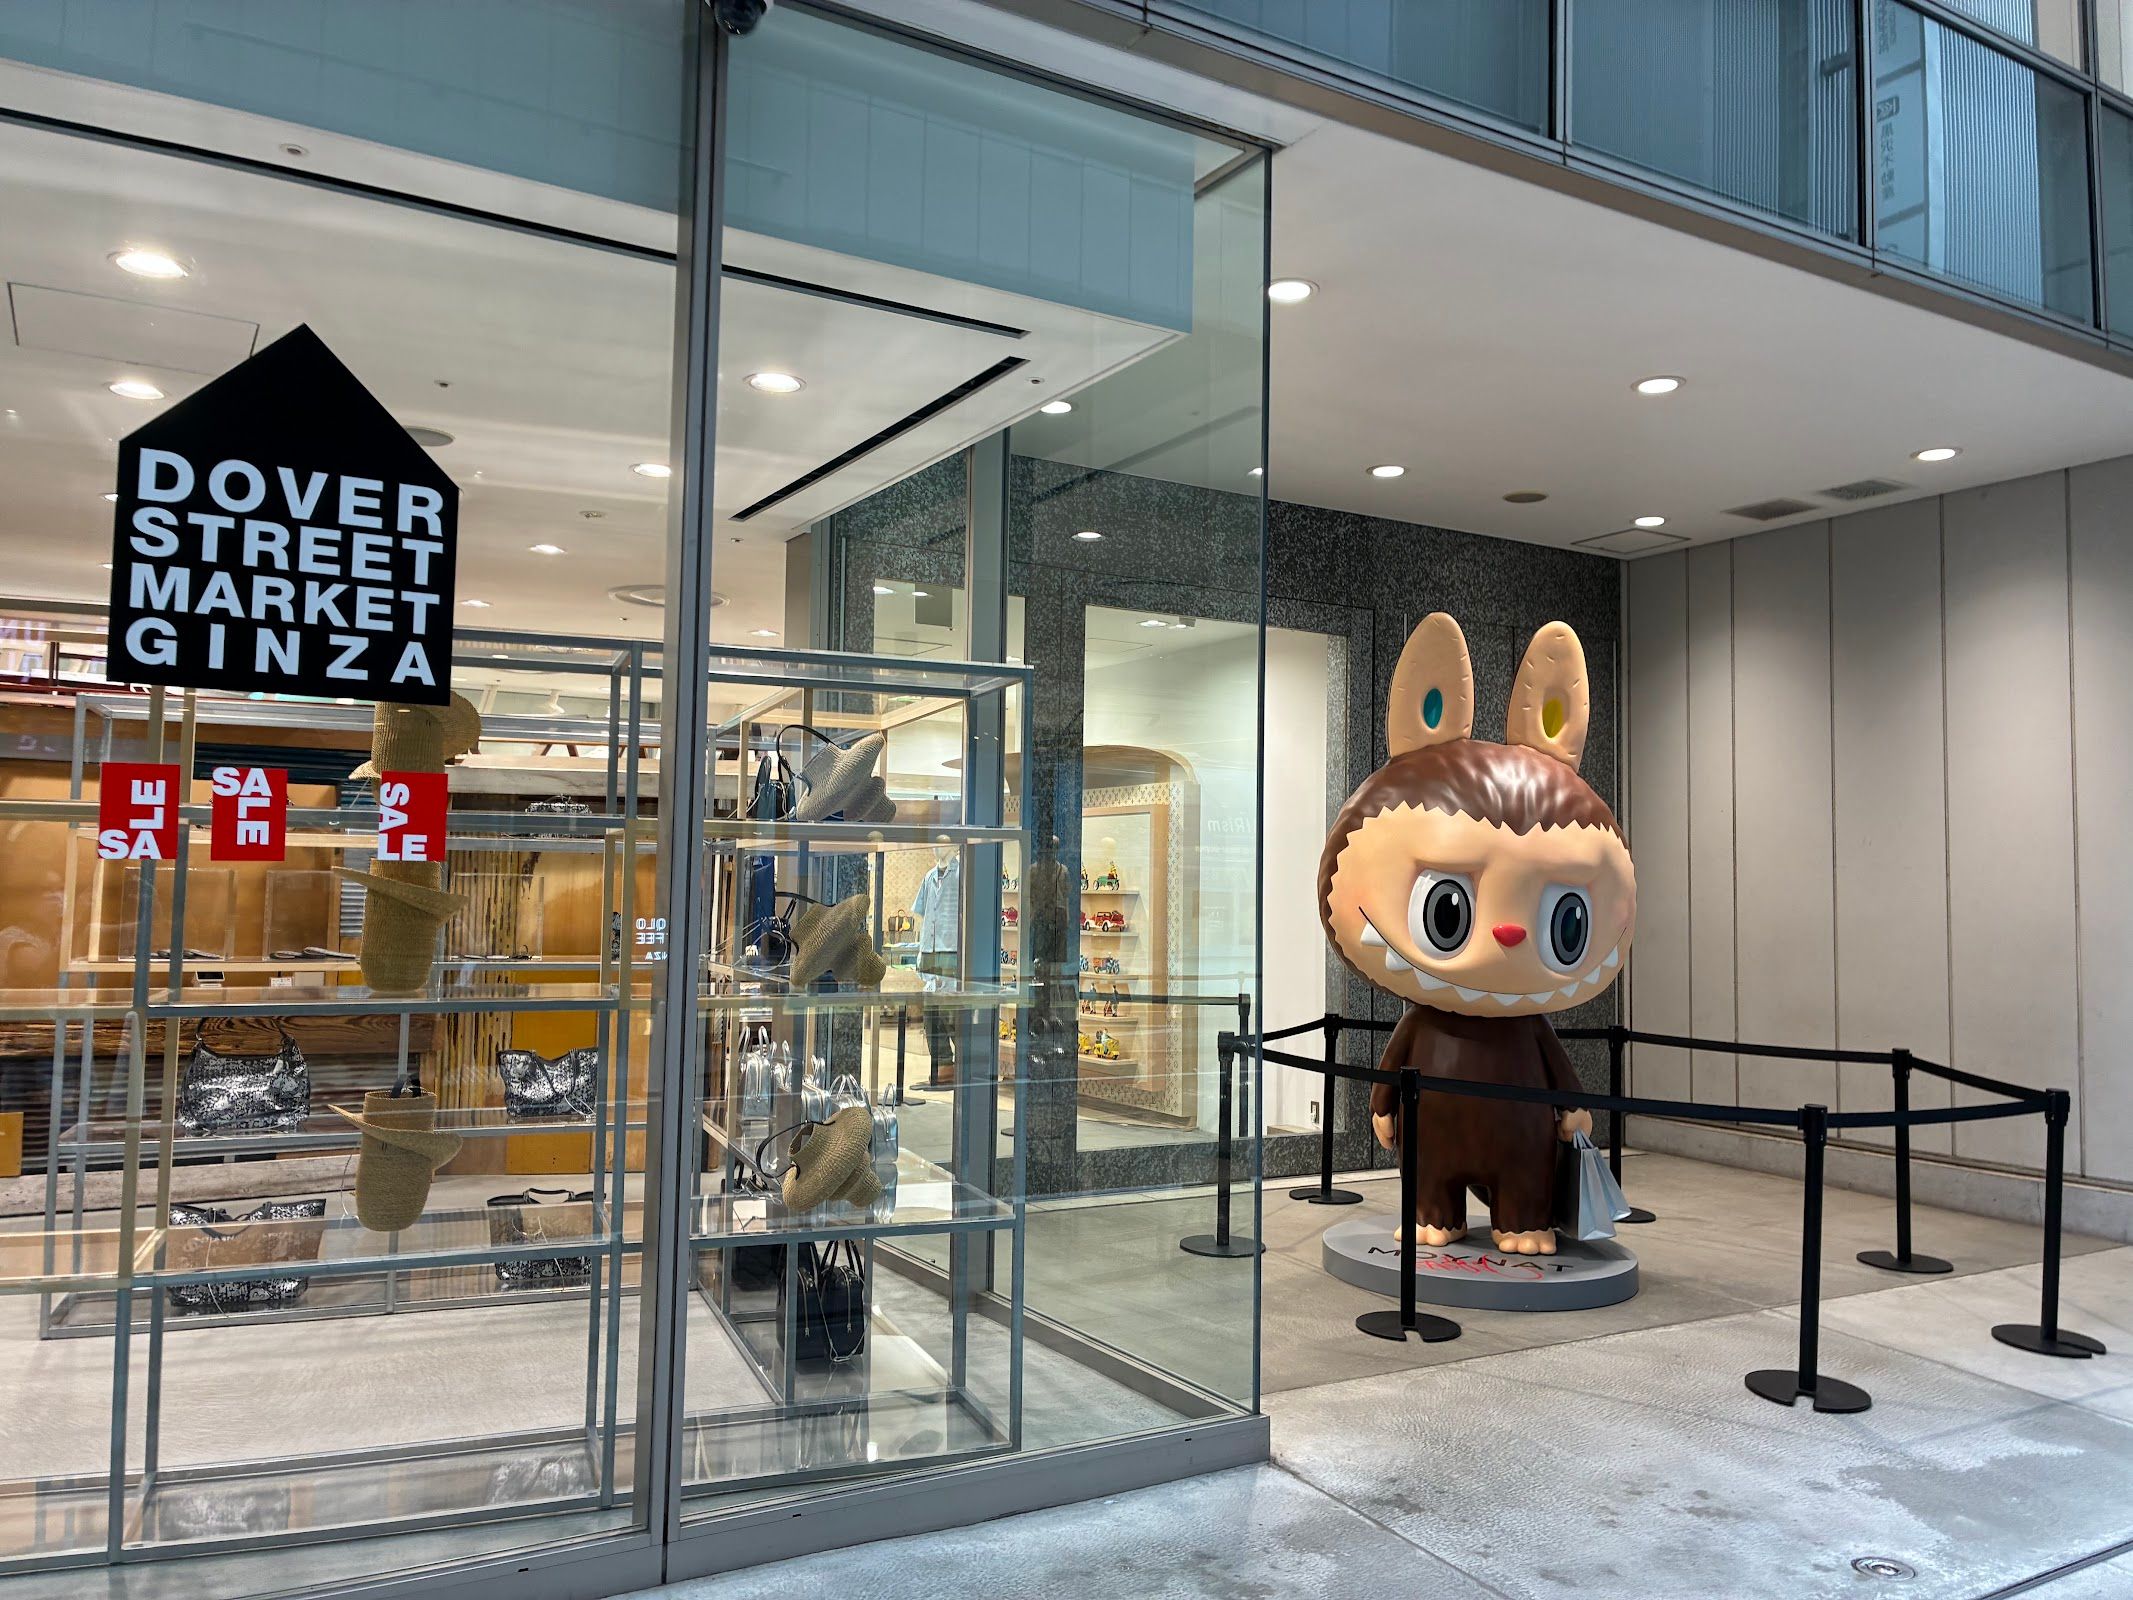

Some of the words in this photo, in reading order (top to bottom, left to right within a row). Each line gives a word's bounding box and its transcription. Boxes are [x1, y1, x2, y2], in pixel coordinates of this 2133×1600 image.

[137, 447, 444, 537] DOVER
[129, 506, 444, 586] STREET
[129, 562, 440, 636] MARKET
[125, 617, 436, 686] GINZA
